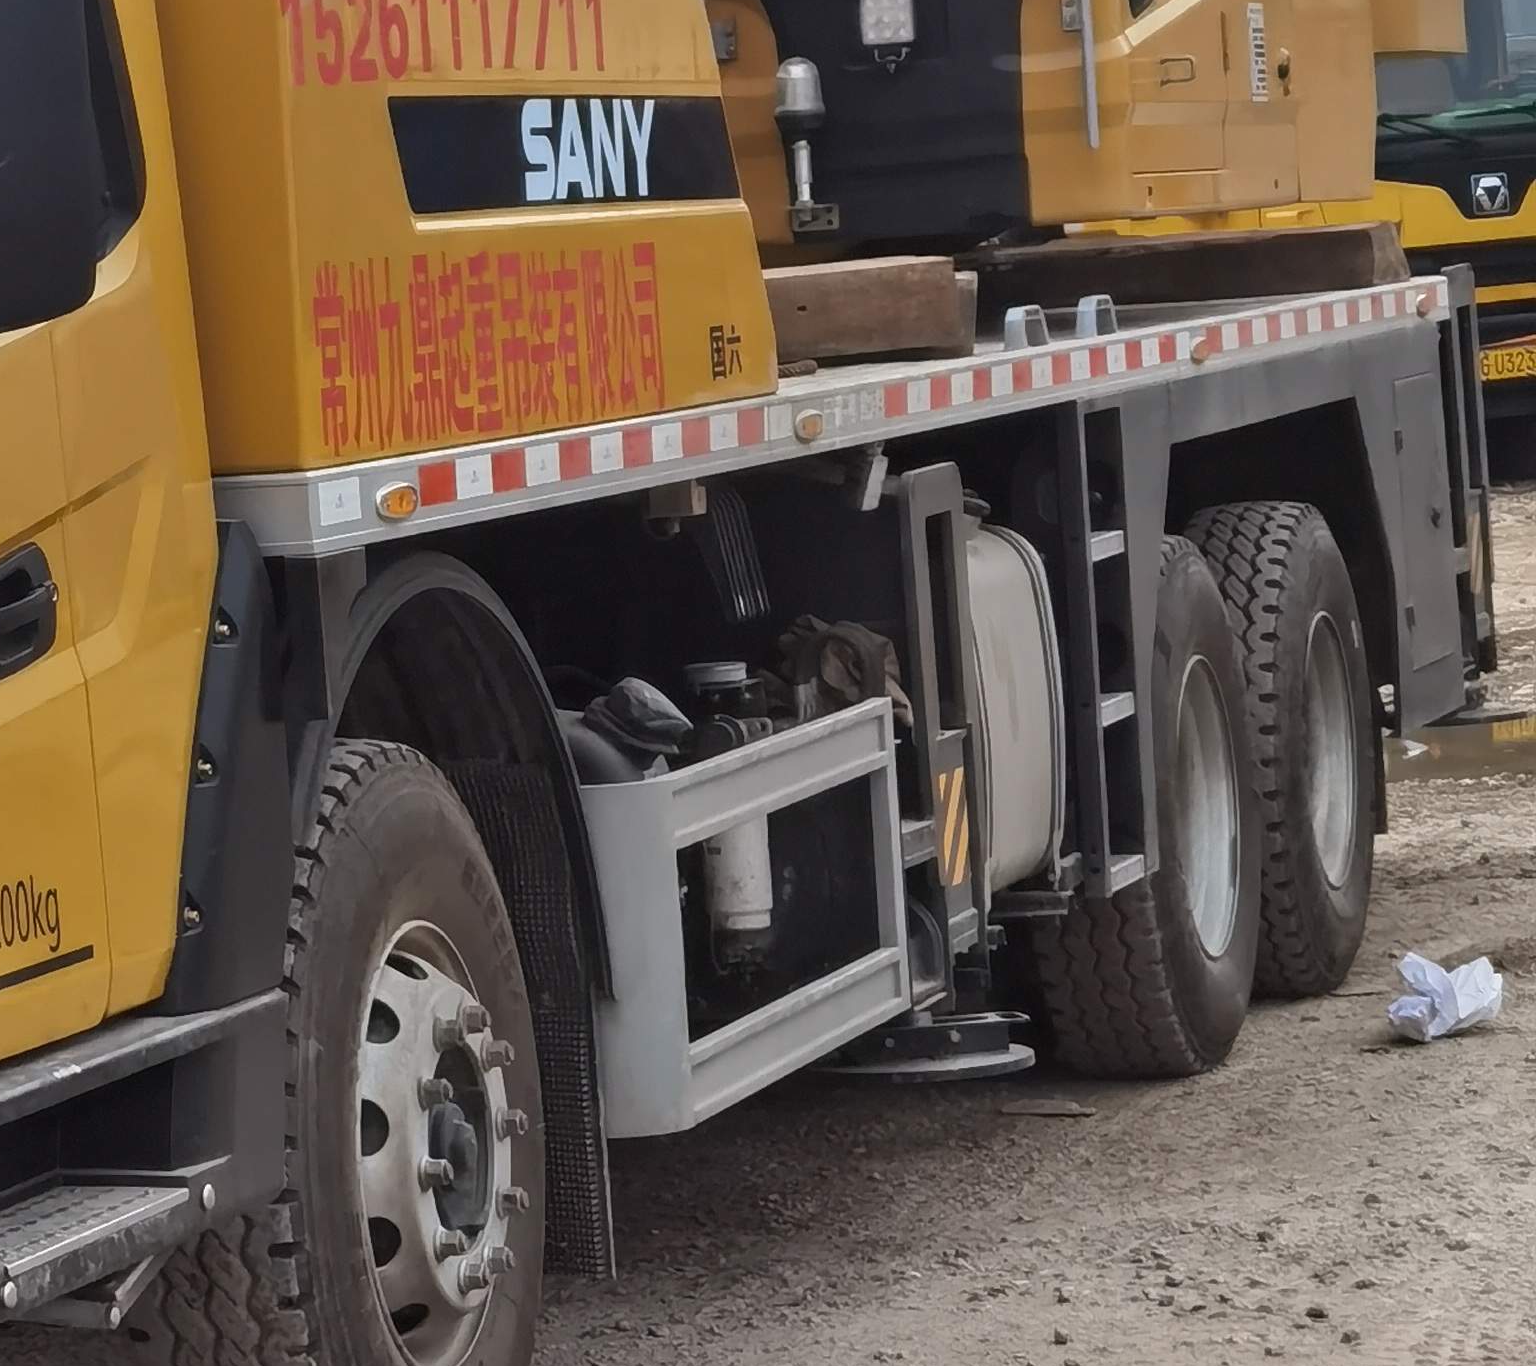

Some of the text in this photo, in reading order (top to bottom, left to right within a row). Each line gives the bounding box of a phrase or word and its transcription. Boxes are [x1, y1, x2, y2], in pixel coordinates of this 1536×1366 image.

[520, 98, 655, 202] SANY
[313, 241, 664, 458] 常州九鼎起重吊装有限公司
[709, 324, 743, 381] 国六
